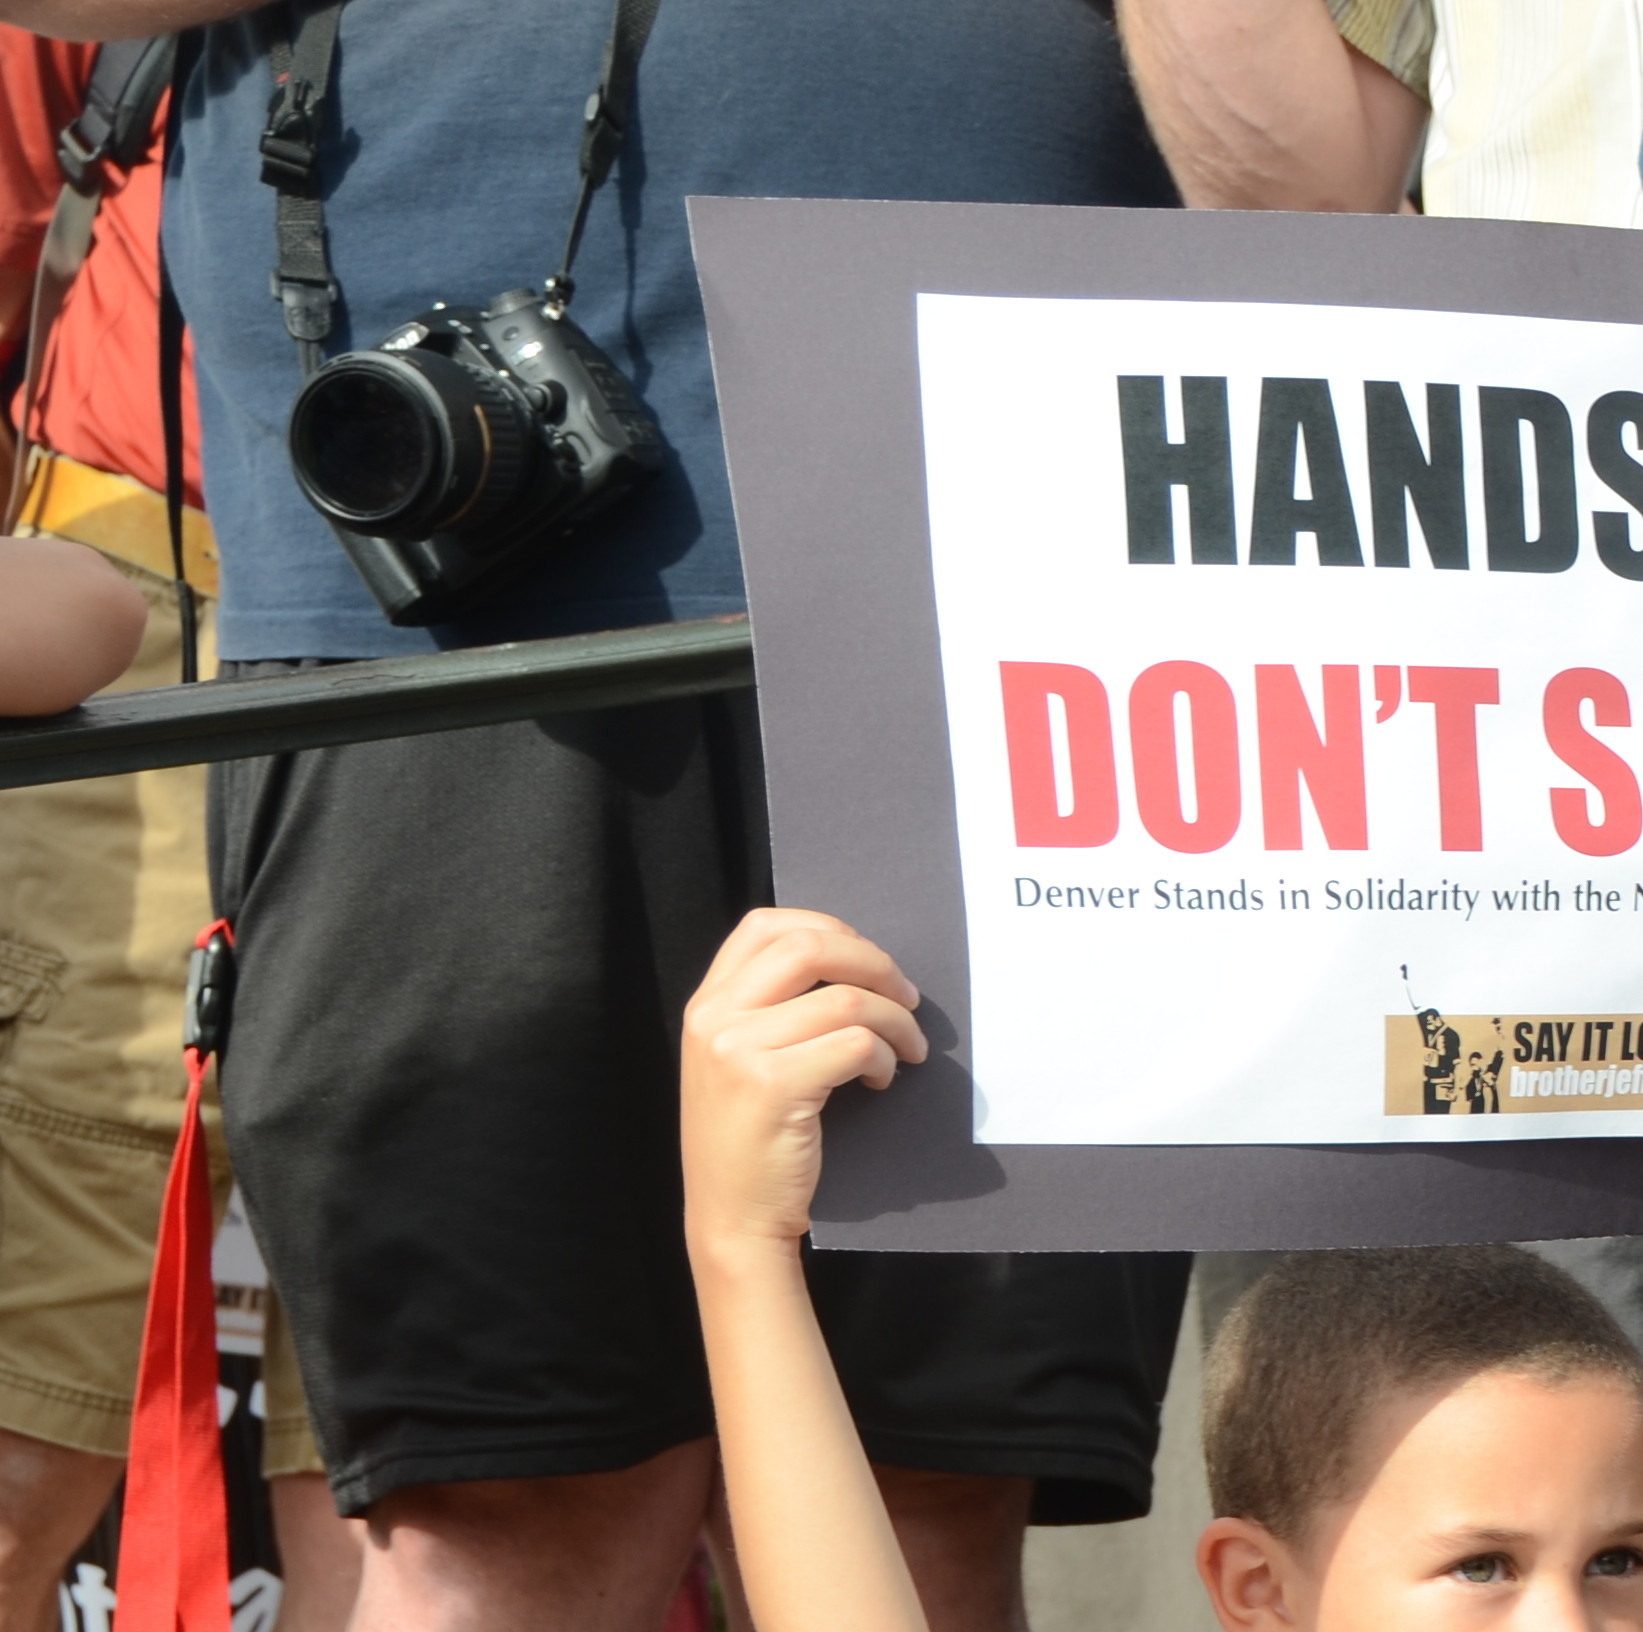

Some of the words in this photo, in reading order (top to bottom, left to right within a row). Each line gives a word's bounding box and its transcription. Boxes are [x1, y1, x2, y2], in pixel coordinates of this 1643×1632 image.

[999, 660, 1500, 855] DON'T
[1014, 877, 1141, 909] Denver
[1153, 878, 1265, 911] Stands
[1278, 878, 1310, 911] in
[1324, 878, 1480, 921] Solidarity
[1491, 878, 1561, 912] with
[1573, 879, 1621, 912] the
[1514, 1021, 1576, 1063] SAY
[1582, 1021, 1615, 1062] IT
